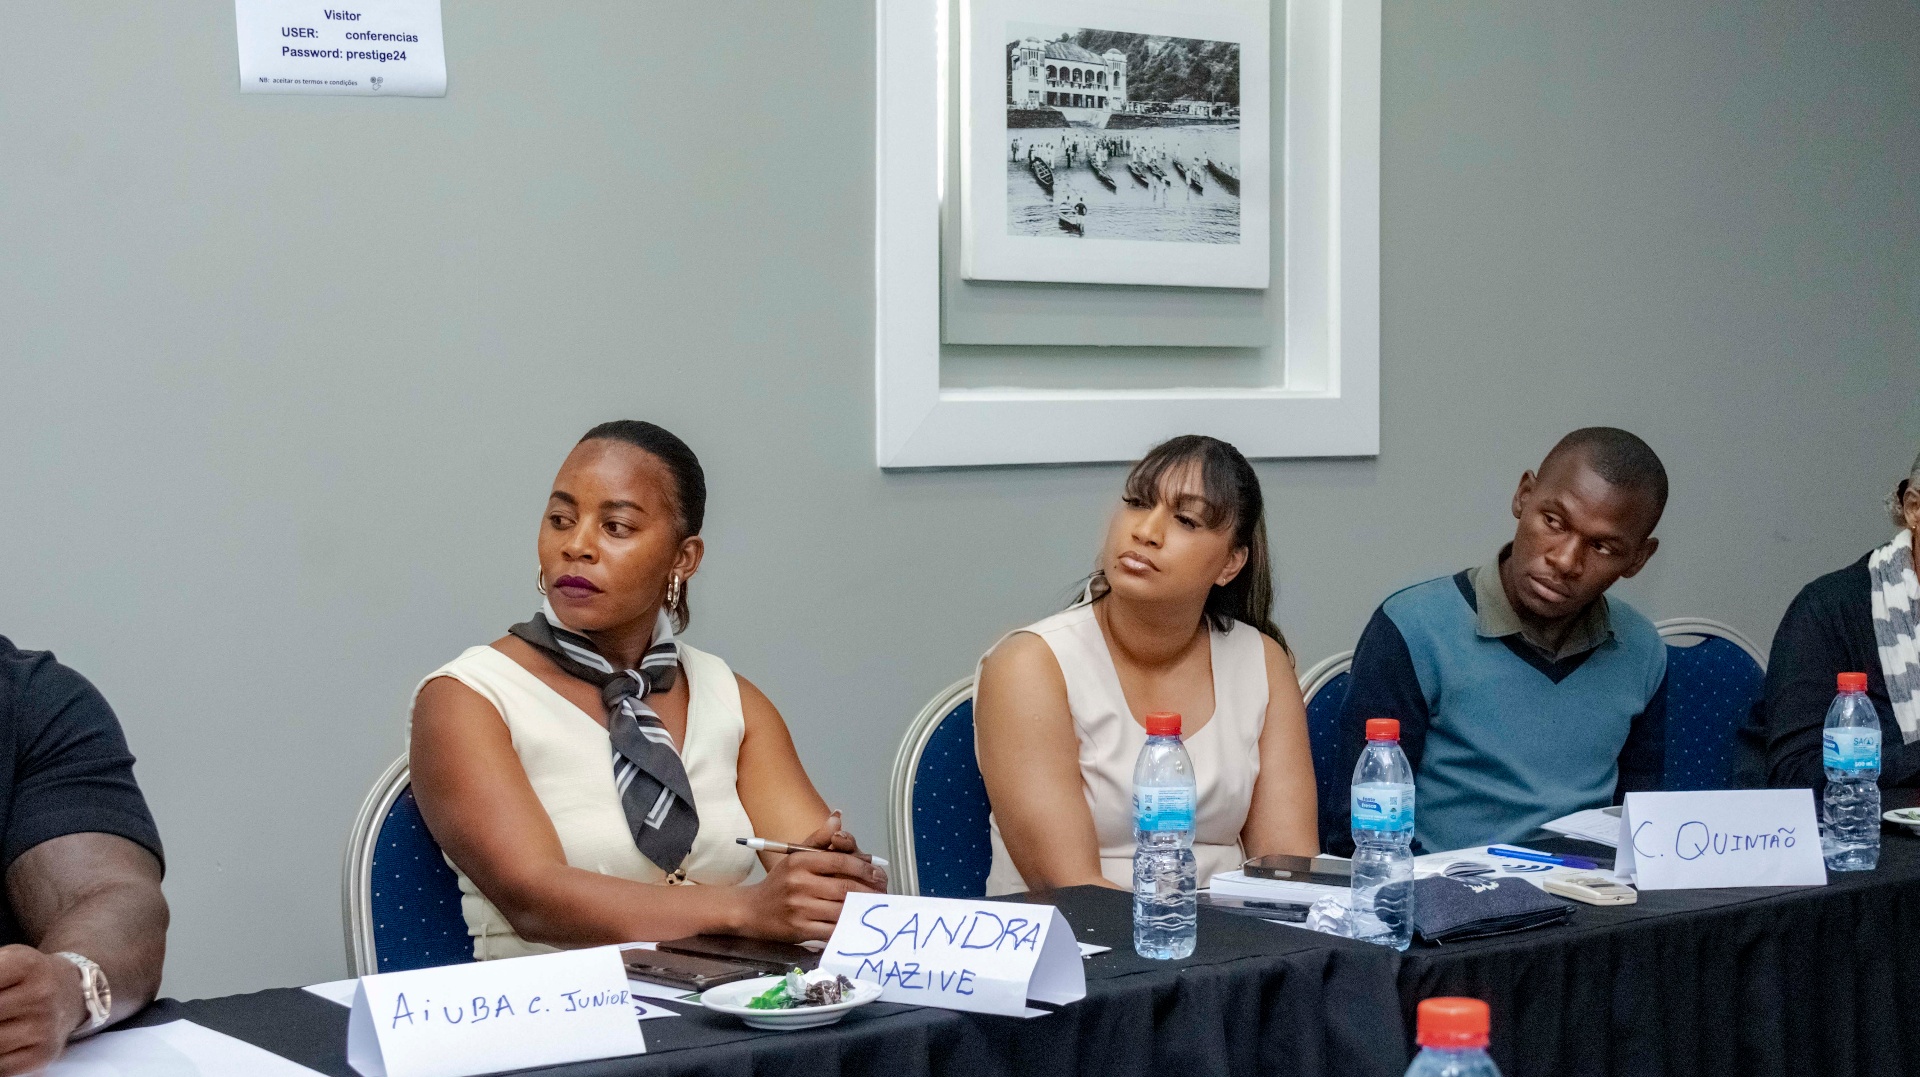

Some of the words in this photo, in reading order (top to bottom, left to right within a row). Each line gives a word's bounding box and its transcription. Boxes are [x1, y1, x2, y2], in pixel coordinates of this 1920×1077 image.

[324, 9, 362, 22] Visitor
[281, 26, 319, 39] USER:
[345, 30, 419, 43] conferencias
[281, 46, 343, 59] Password:
[346, 49, 407, 63] prestige24
[272, 77, 293, 85] aceitar
[302, 78, 323, 86] termos
[329, 79, 358, 87] condições
[1632, 820, 1664, 858] C.
[837, 903, 1041, 956] SANDRA
[855, 958, 977, 995] MAZIVE
